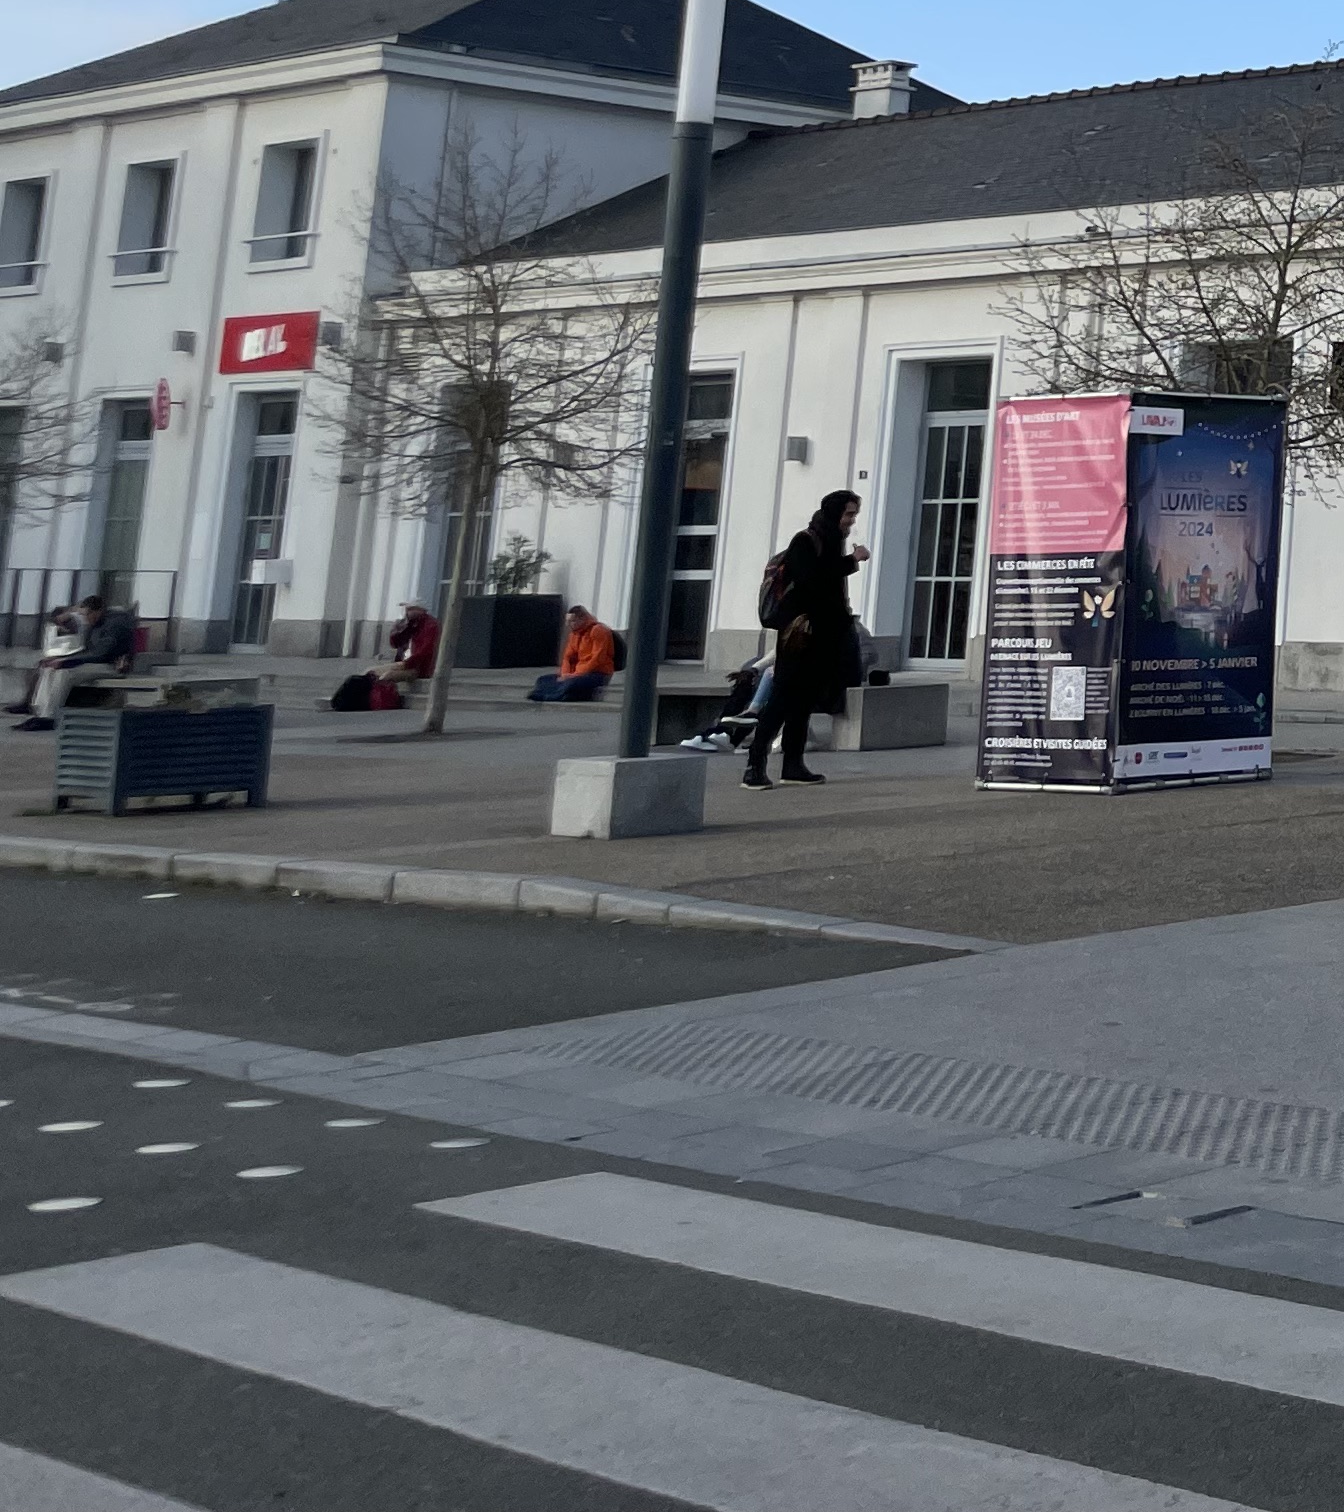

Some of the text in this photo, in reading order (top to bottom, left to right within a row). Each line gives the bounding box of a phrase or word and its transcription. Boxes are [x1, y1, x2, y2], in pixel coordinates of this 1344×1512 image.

[1178, 521, 1214, 537] 2024
[997, 561, 1015, 571] LES
[1142, 658, 1200, 671] NOVEMBRE
[1218, 656, 1258, 669] JANVIER
